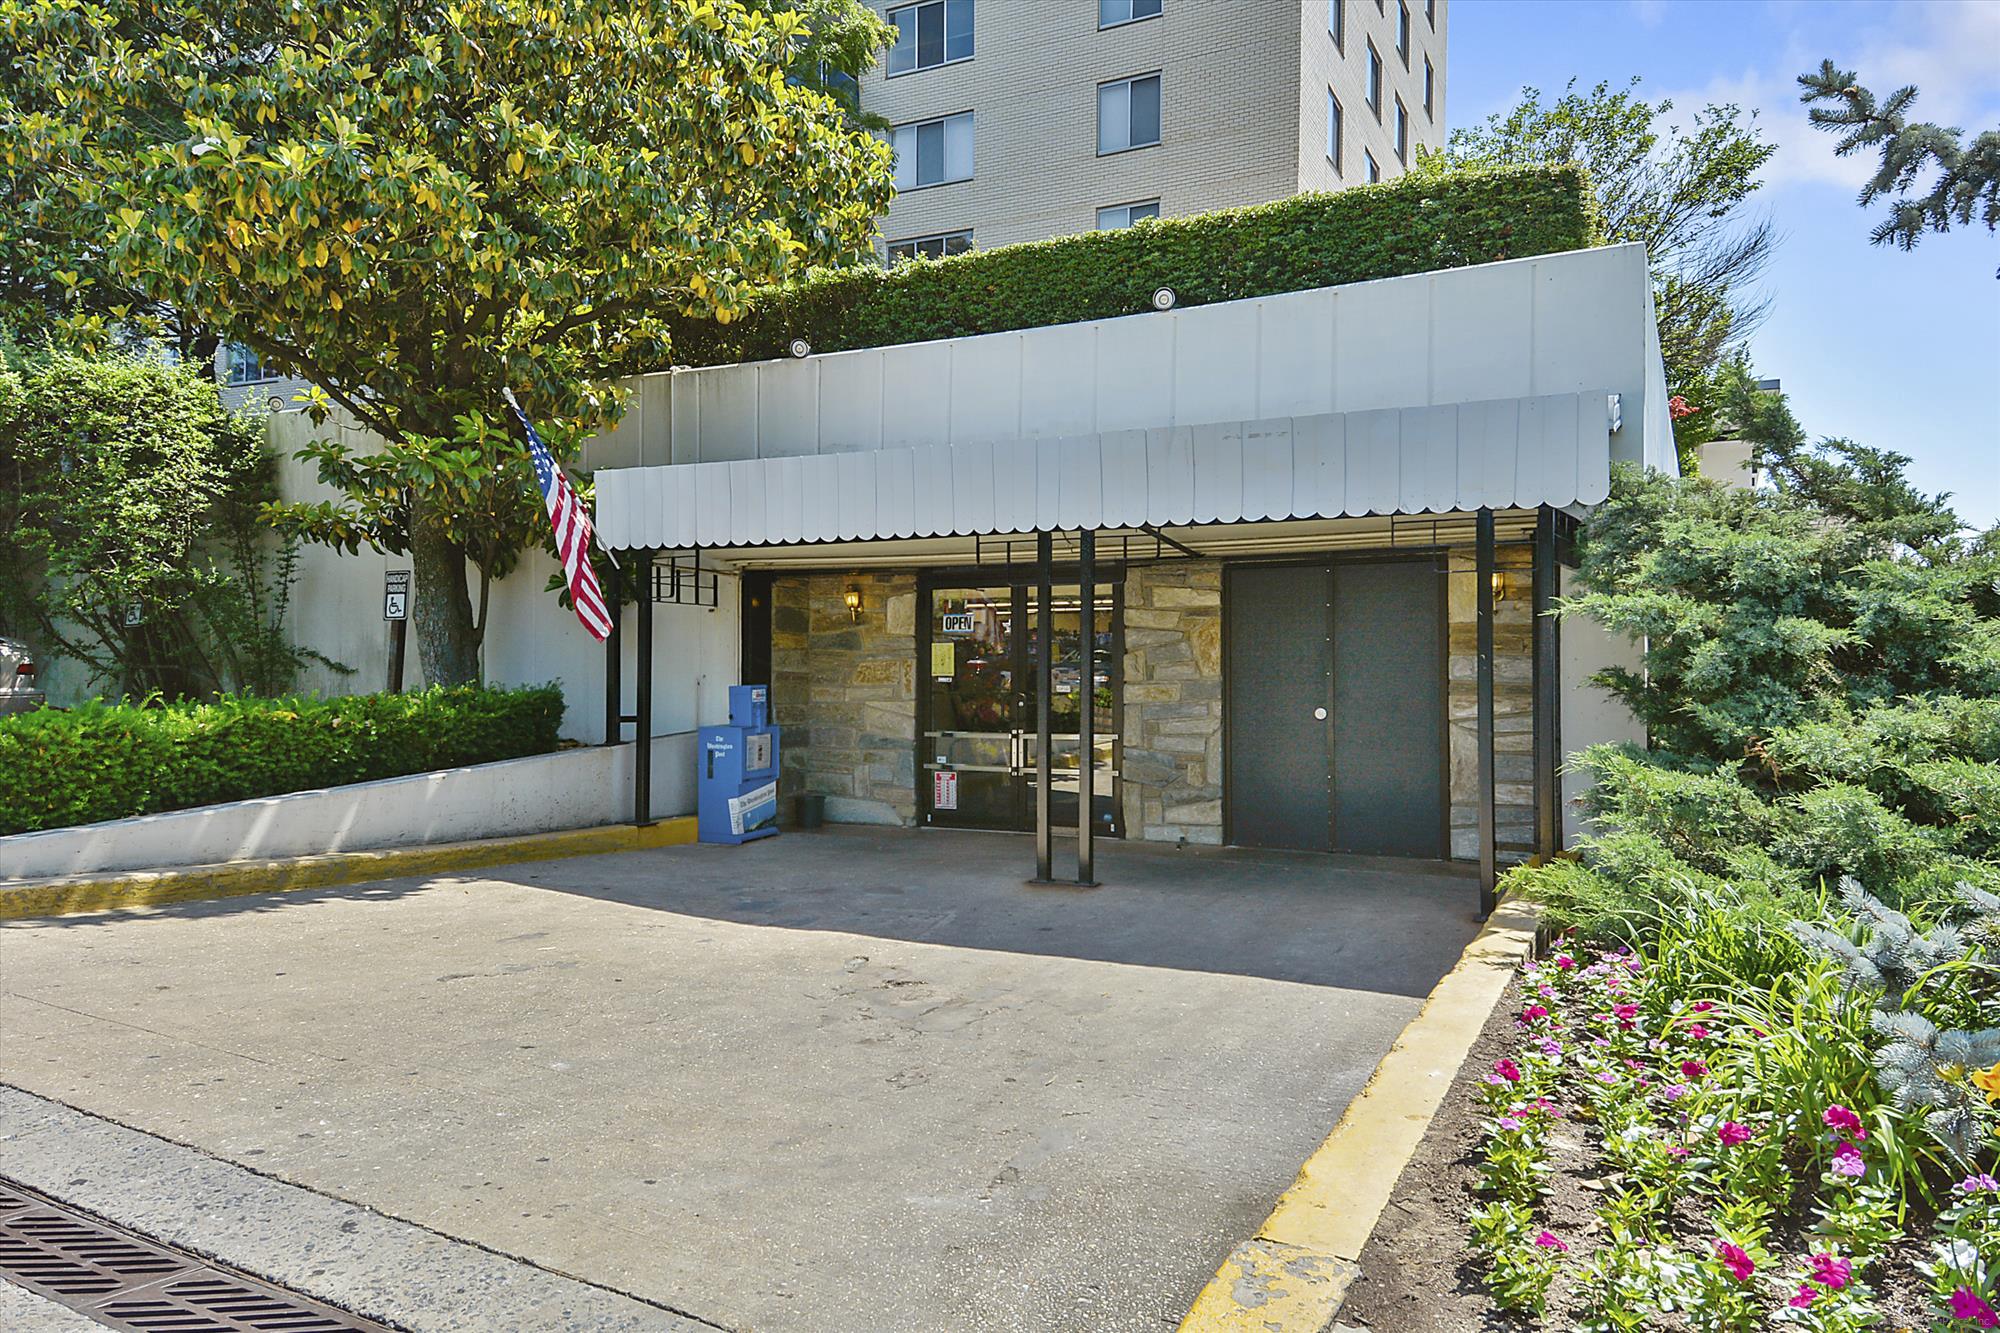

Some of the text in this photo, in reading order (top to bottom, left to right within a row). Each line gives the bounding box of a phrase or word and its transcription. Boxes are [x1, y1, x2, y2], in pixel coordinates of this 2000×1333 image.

[386, 575, 408, 583] HANDICAP
[388, 584, 406, 592] PARKING
[945, 616, 972, 630] OPEN
